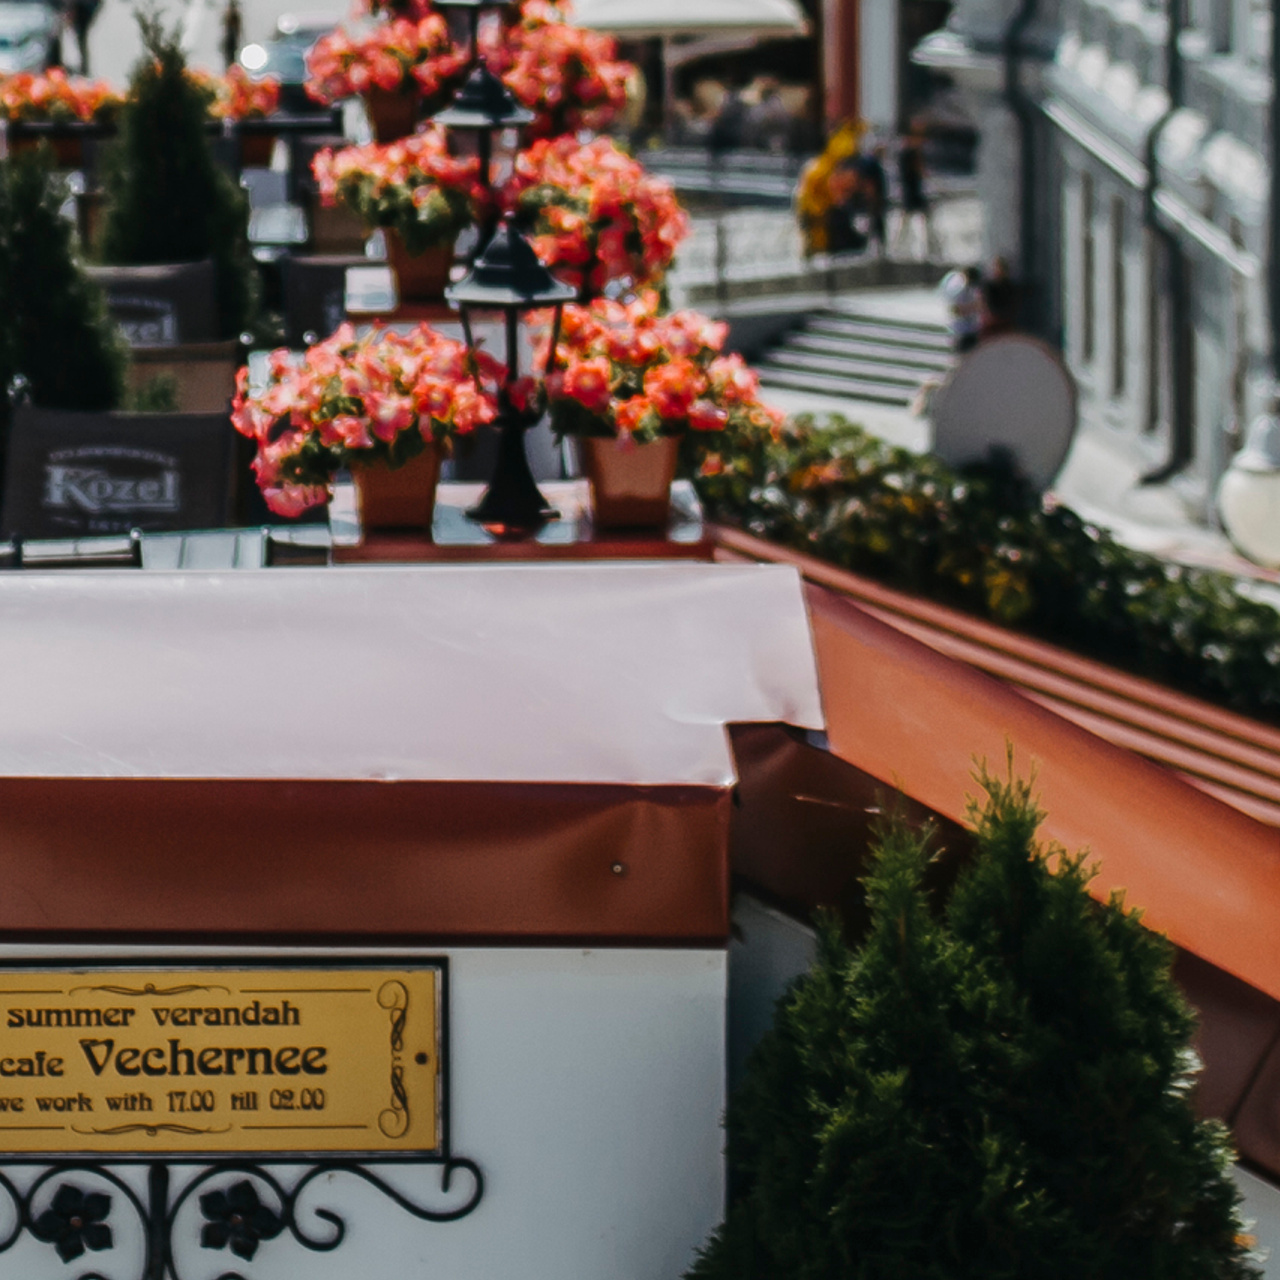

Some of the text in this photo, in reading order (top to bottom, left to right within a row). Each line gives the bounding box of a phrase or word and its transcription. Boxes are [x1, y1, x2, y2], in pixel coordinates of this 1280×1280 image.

[43, 464, 180, 512] Kozel
[7, 1000, 301, 1028] summer verandah
[78, 1038, 328, 1076] Vechernee
[35, 1092, 94, 1112] work
[105, 1092, 153, 1112] with
[167, 1090, 215, 1112] 17.00
[231, 1091, 259, 1111] till
[269, 1088, 325, 1111] 02.00
